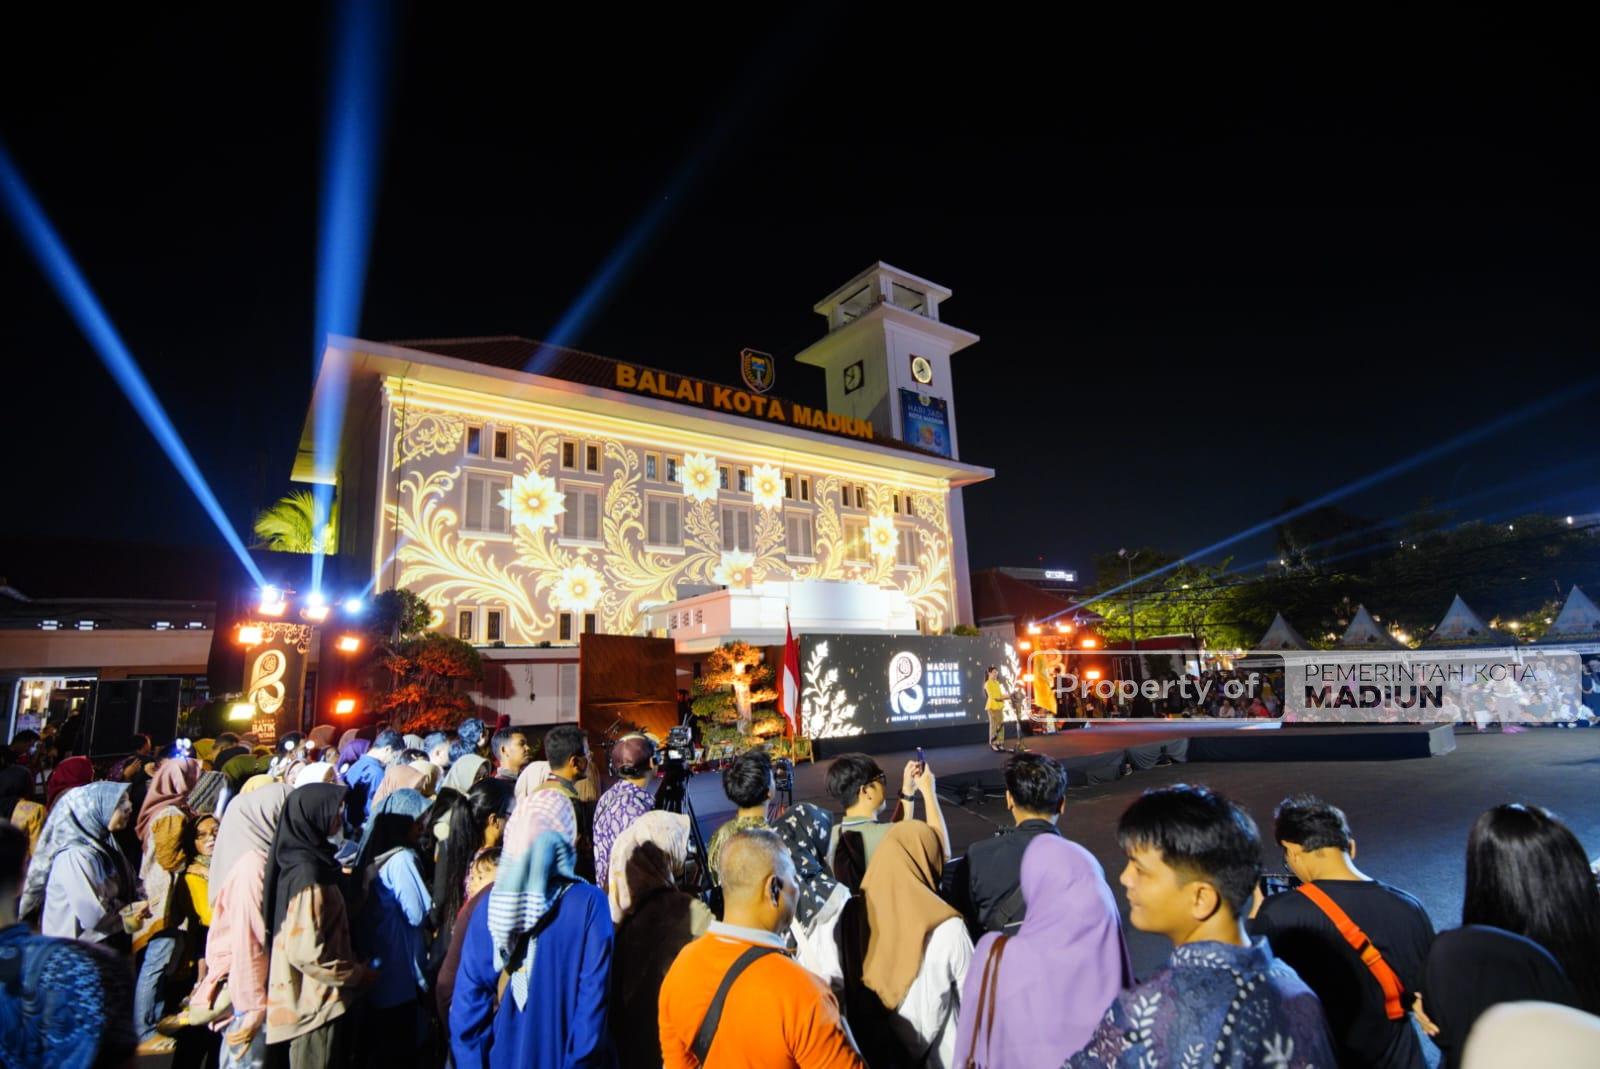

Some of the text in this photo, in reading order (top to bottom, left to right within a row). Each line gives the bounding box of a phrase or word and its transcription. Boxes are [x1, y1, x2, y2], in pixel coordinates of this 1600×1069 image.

[615, 363, 873, 439] BALAI KOTA MADIUN
